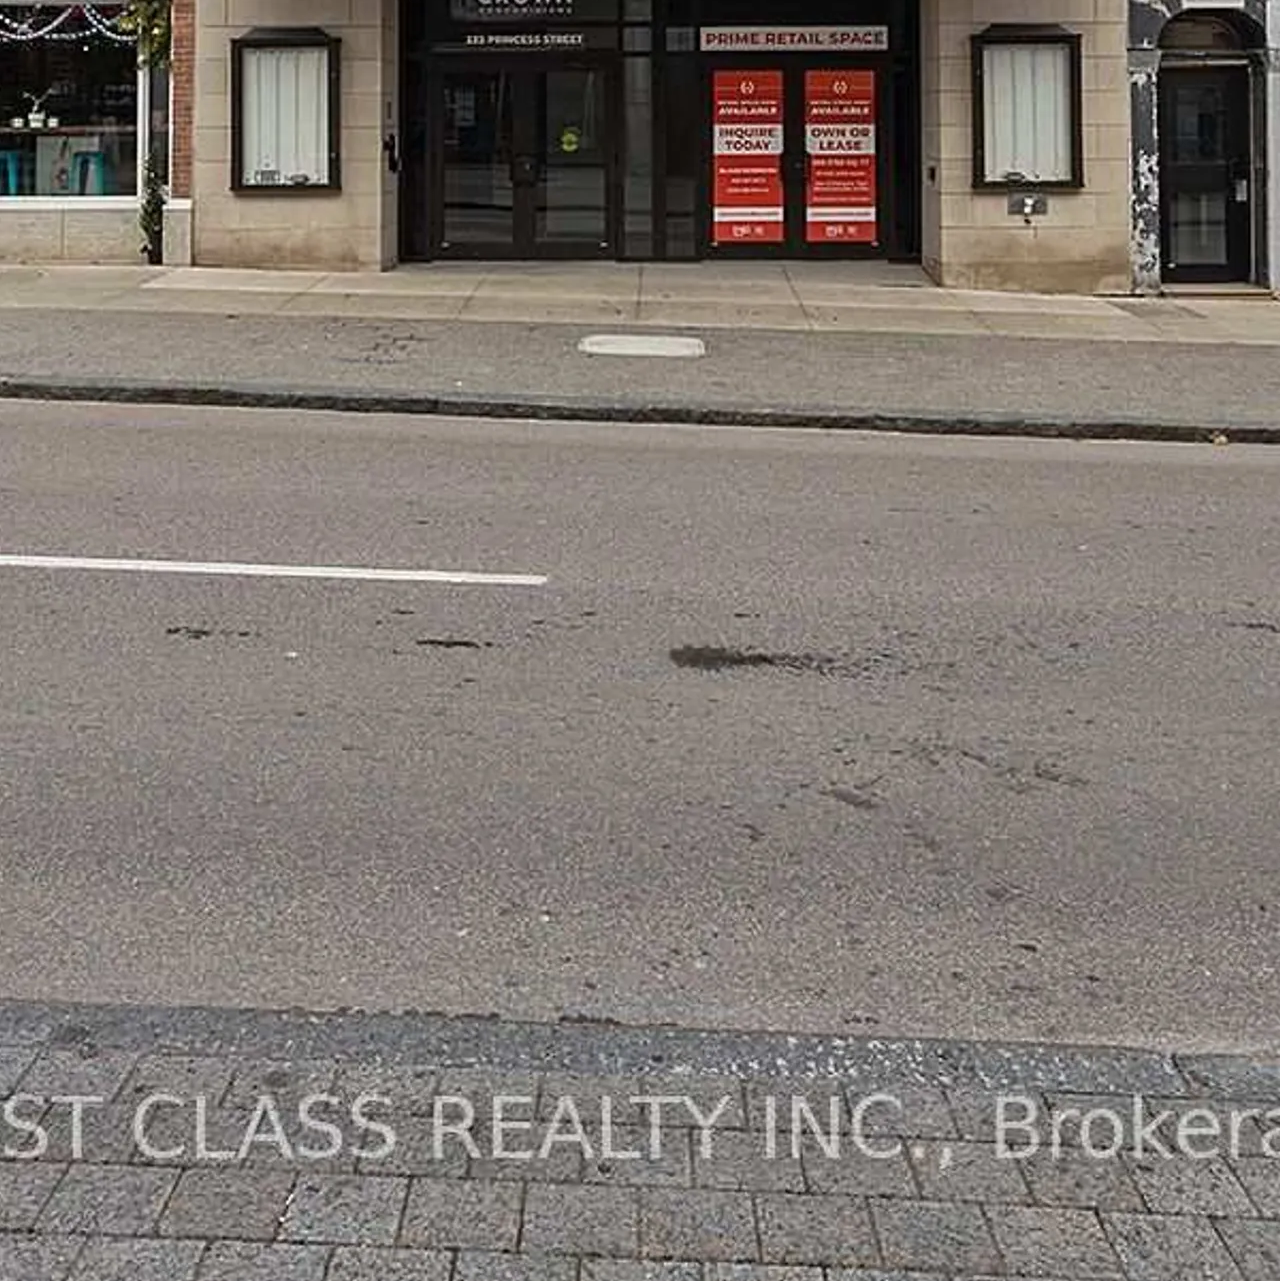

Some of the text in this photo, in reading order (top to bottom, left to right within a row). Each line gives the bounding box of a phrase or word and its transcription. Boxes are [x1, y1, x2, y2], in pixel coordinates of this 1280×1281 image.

[705, 32, 885, 46] PRIME RETAIL SPACE
[718, 106, 778, 116] AVAILABLE
[810, 106, 870, 116] AVAILABLE
[719, 127, 776, 138] INQUIRE
[811, 127, 870, 138] OWN OR
[725, 140, 772, 151] TODAY
[820, 140, 862, 151] LEASE
